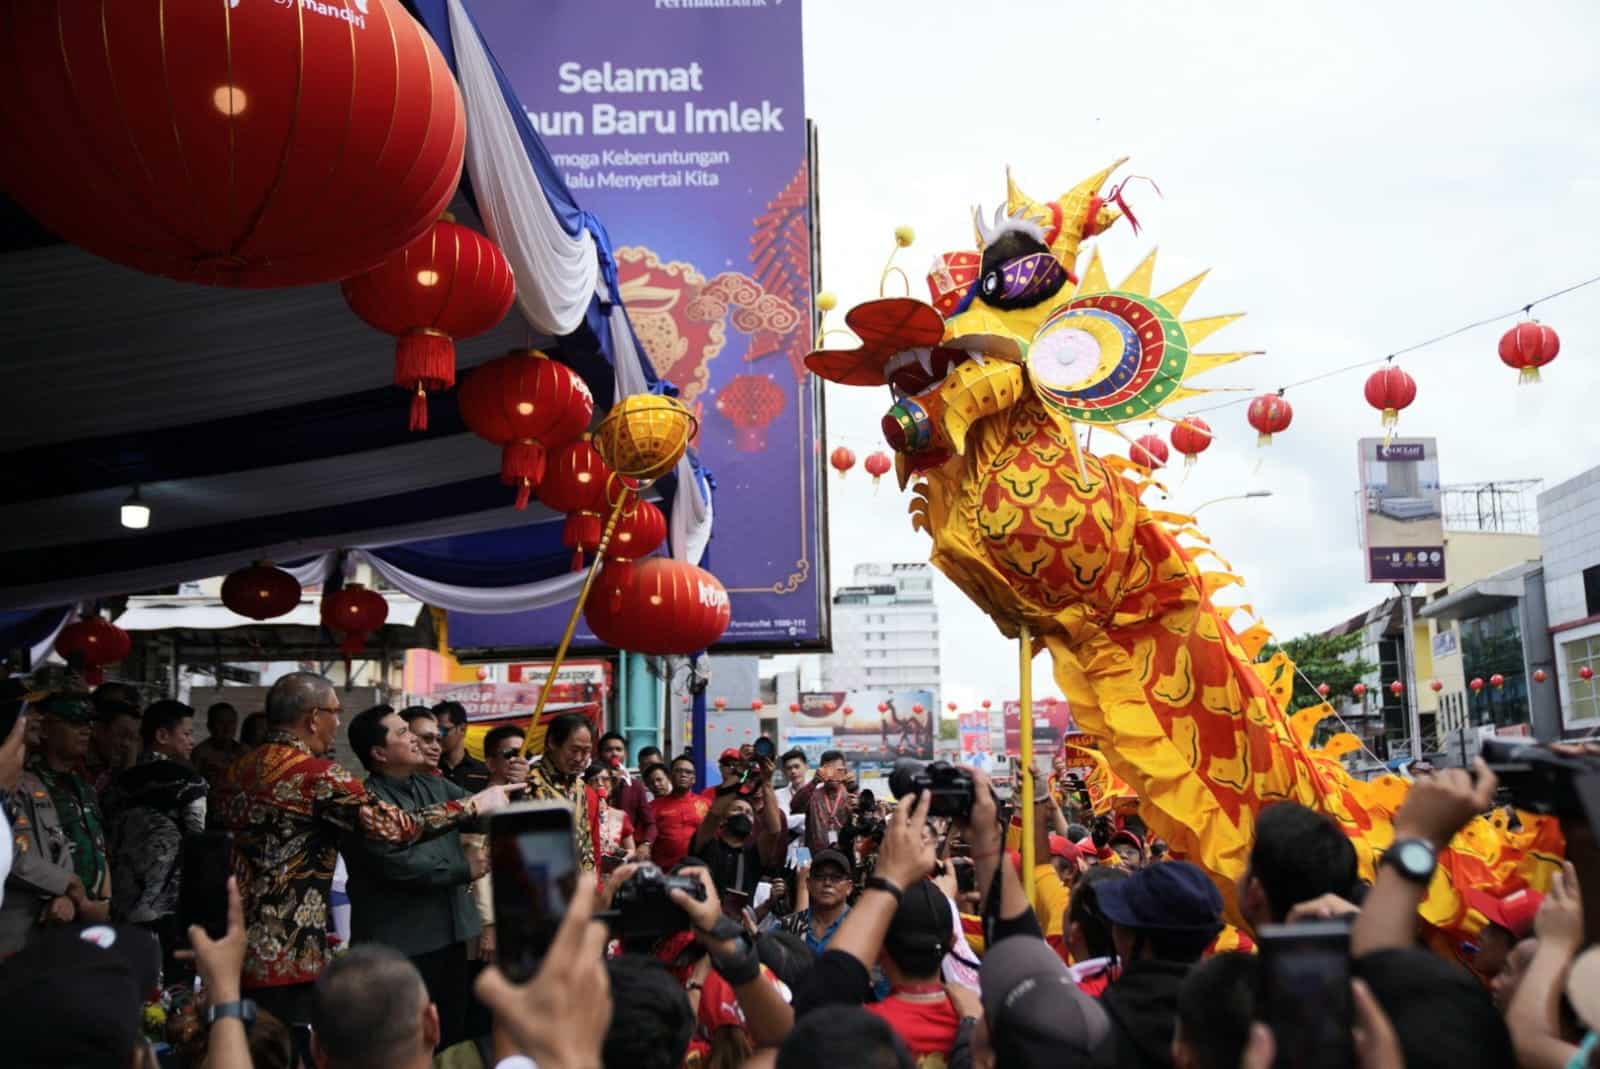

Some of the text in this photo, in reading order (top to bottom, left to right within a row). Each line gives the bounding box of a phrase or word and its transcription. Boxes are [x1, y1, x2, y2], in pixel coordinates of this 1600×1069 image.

[558, 61, 704, 93] Selamat
[592, 103, 676, 135] Baru
[684, 99, 785, 133] Imlek
[553, 148, 730, 169] moga Keberuntungan
[565, 170, 720, 192] lalu Menyertai Kita
